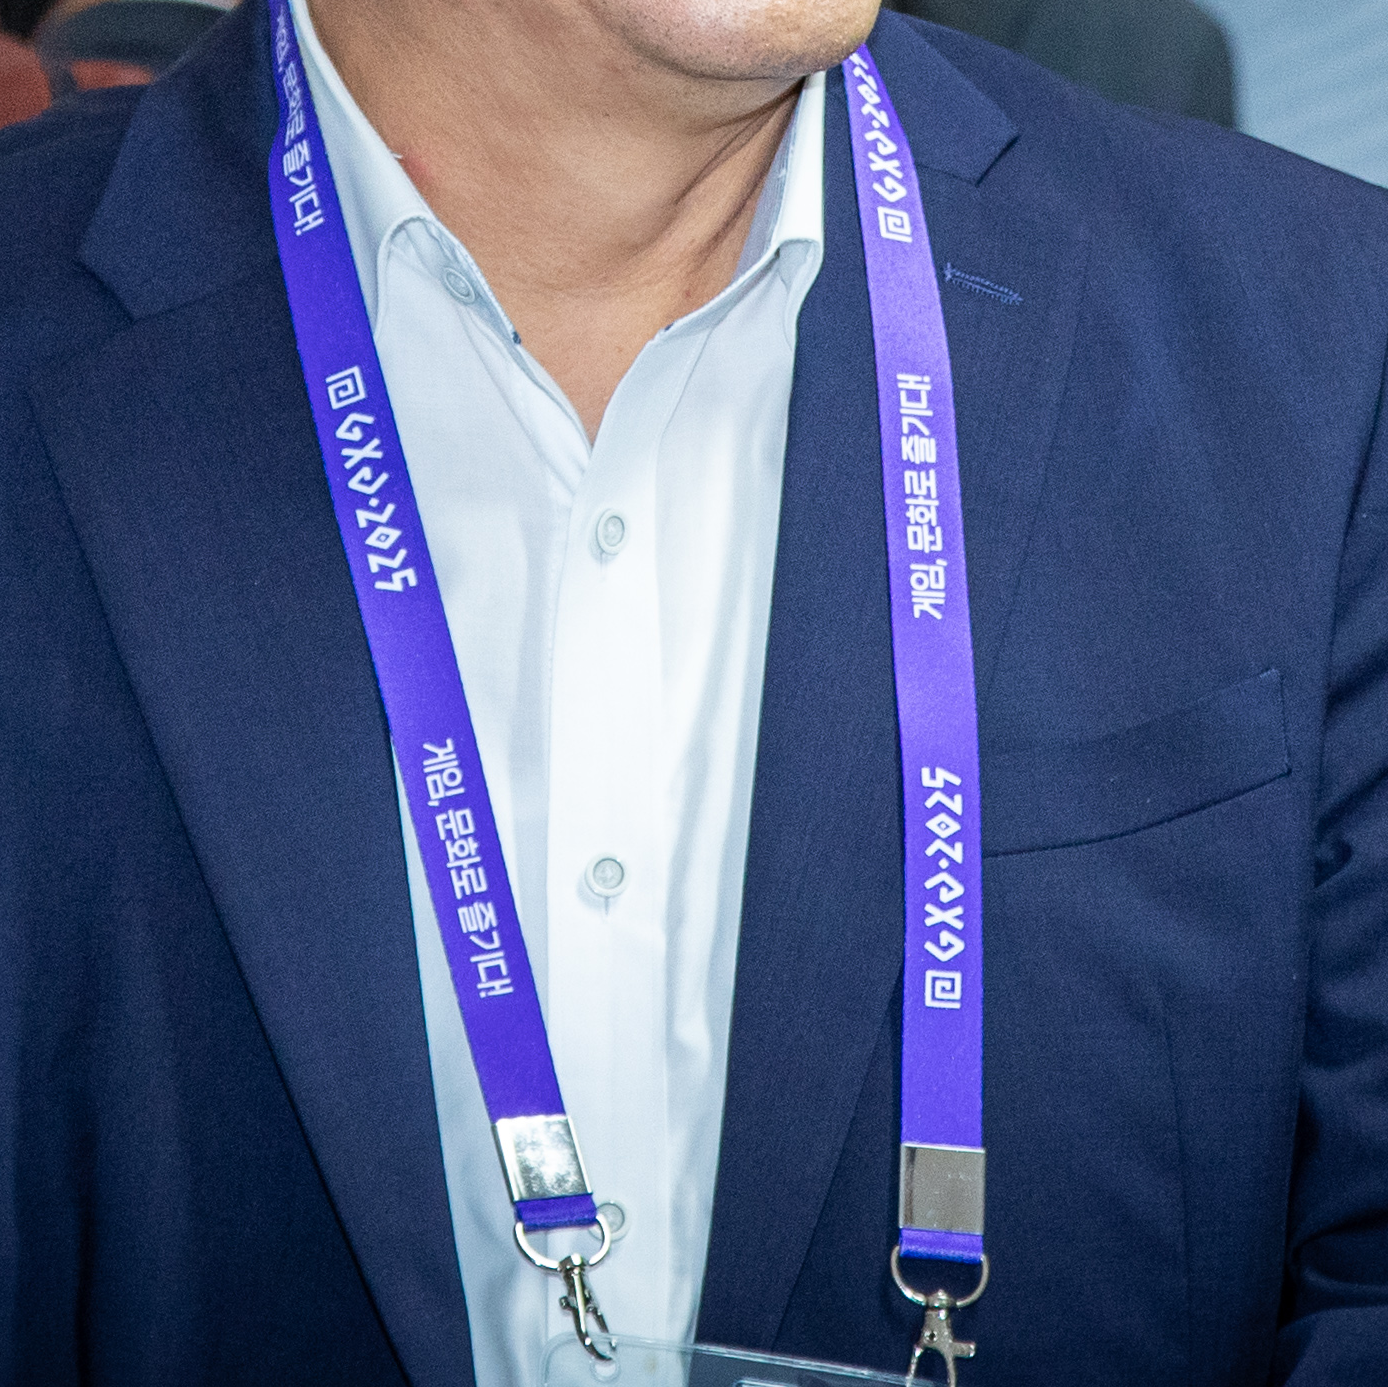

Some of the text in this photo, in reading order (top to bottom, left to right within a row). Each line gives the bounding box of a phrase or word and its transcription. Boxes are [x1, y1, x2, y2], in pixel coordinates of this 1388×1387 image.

[283, 139, 324, 236] 즐기다!
[896, 373, 948, 620] 게임, 문화로 즐기다!
[422, 737, 514, 999] 게임, 문화로 즐기다!
